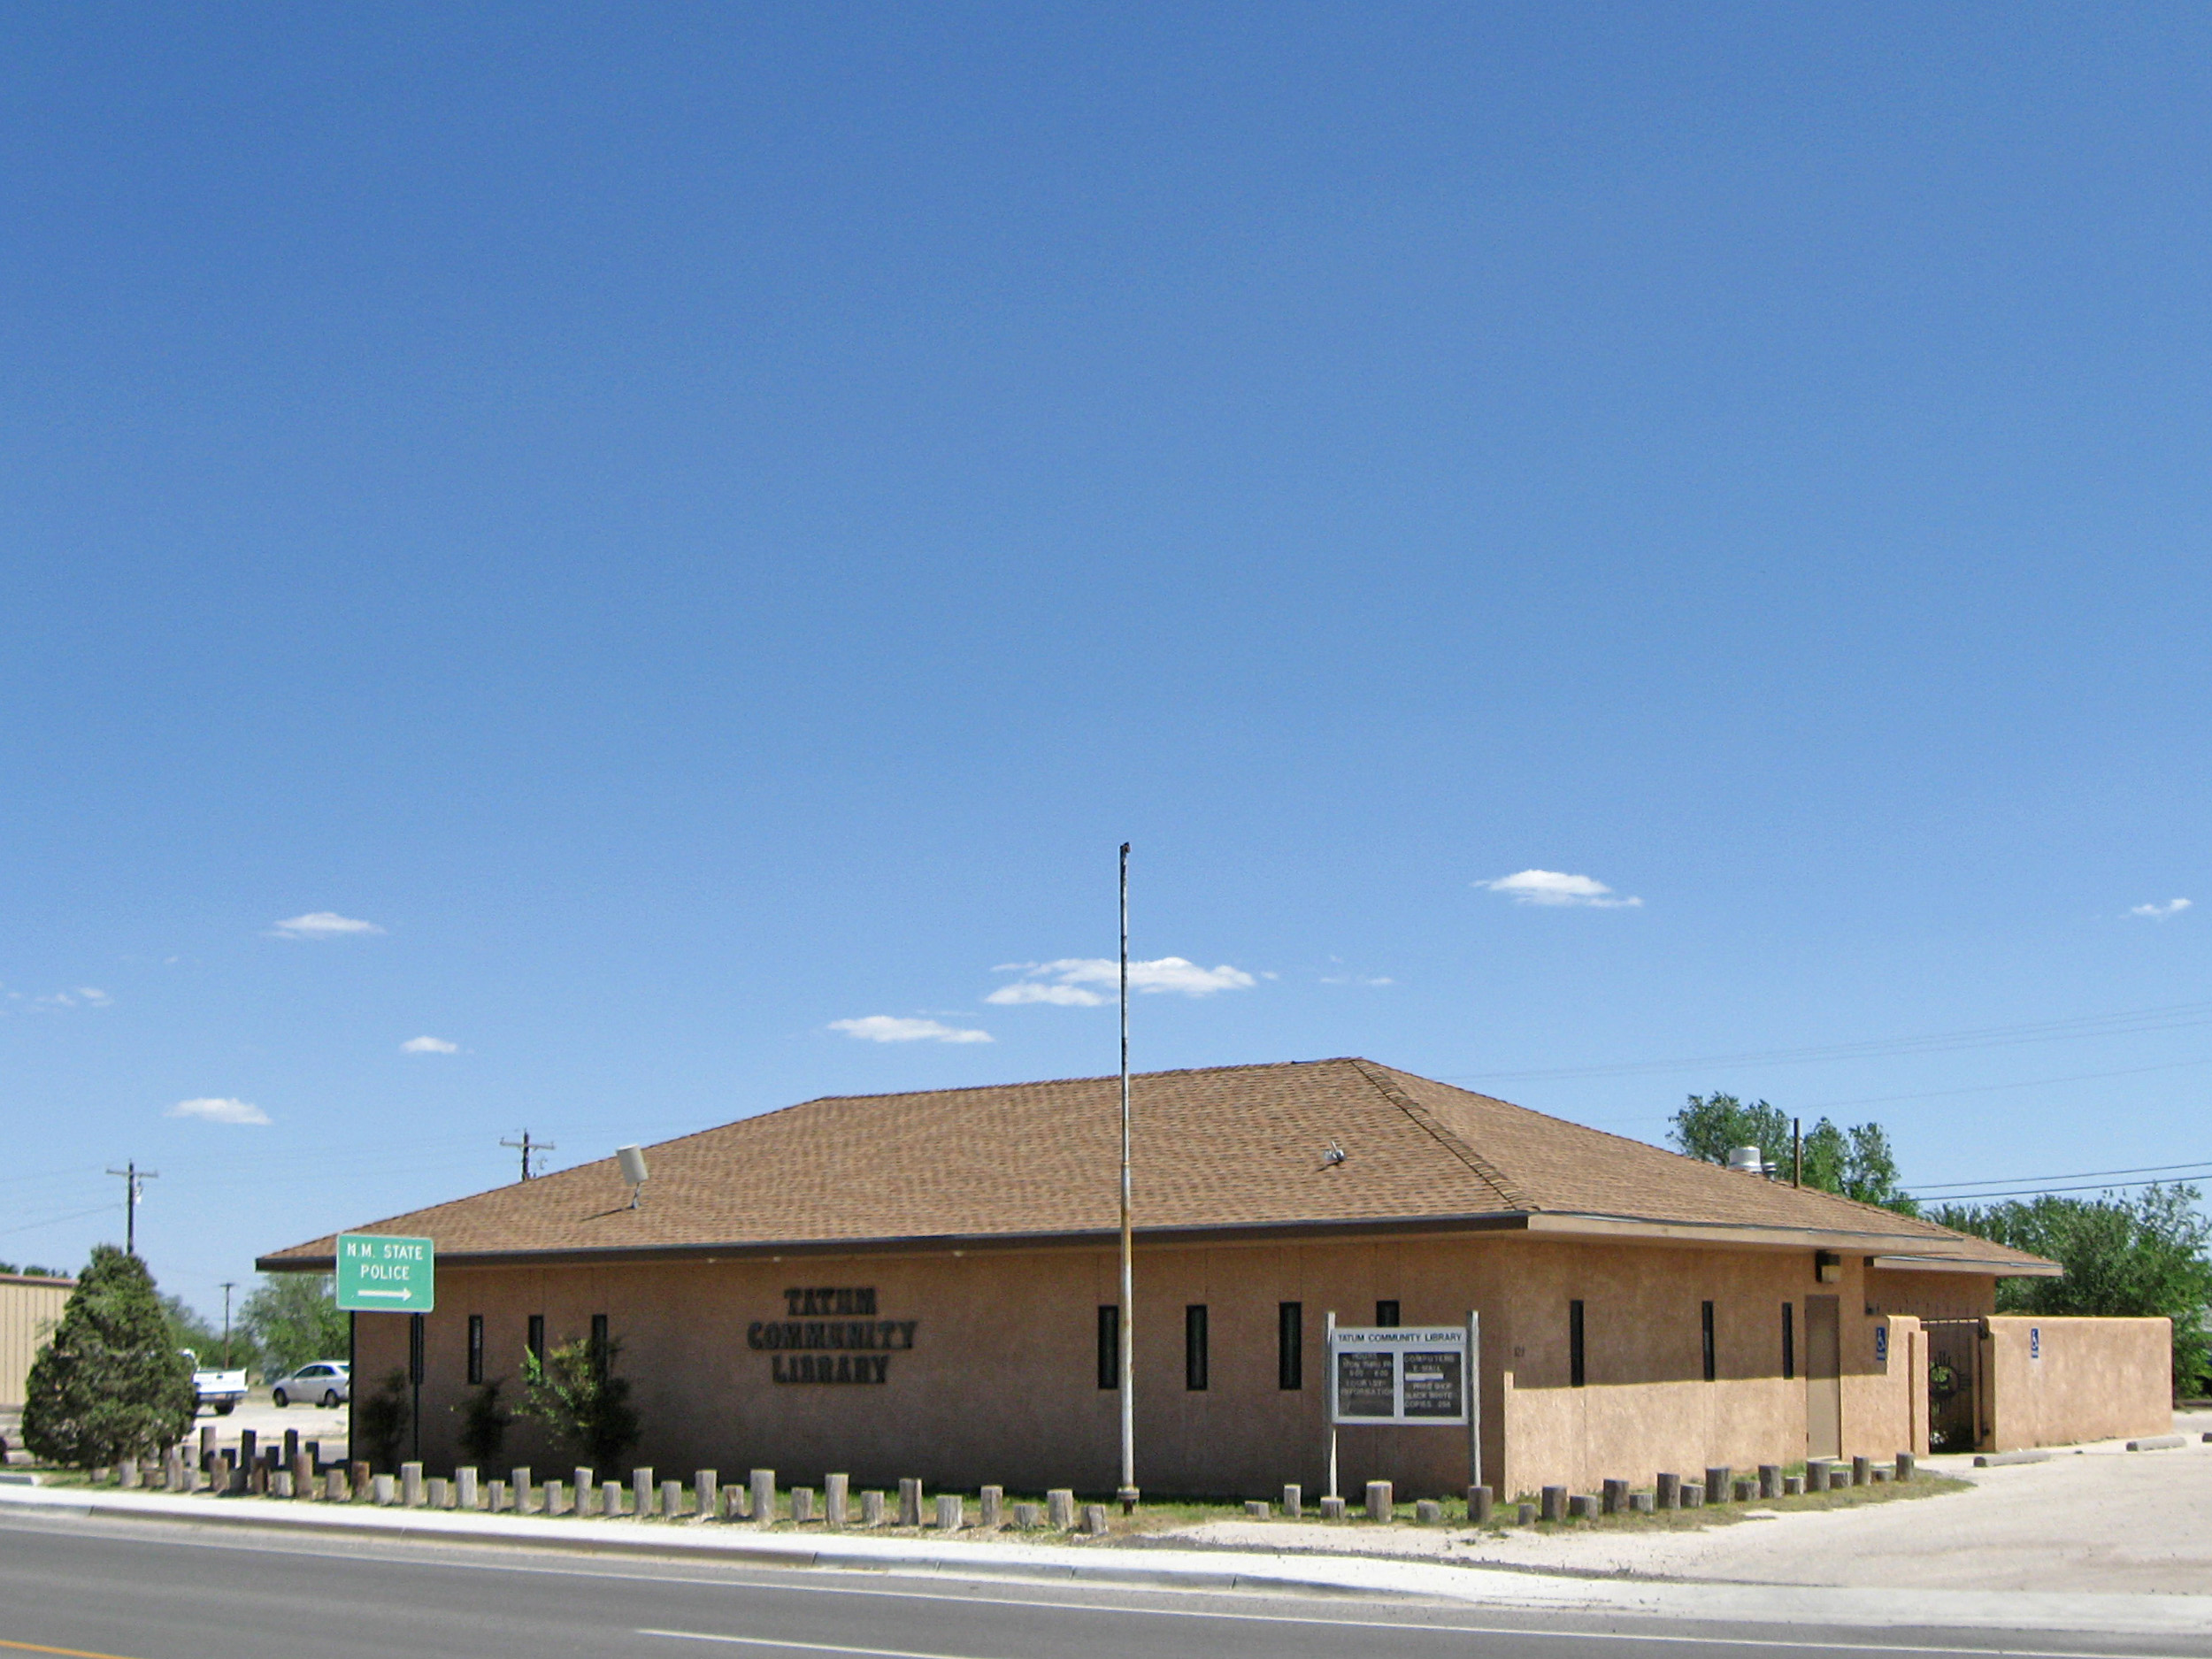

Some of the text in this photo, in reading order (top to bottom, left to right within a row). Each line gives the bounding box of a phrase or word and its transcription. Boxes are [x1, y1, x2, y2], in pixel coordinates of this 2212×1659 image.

[347, 1242, 423, 1260] N.M. STATE
[360, 1263, 410, 1280] POLICE
[784, 1287, 877, 1316] TATUM
[747, 1320, 917, 1349] COMMUNITY
[1338, 1333, 1462, 1342] TATUM COMMUNITY LIBRARY
[771, 1354, 889, 1383] LIBRARY
